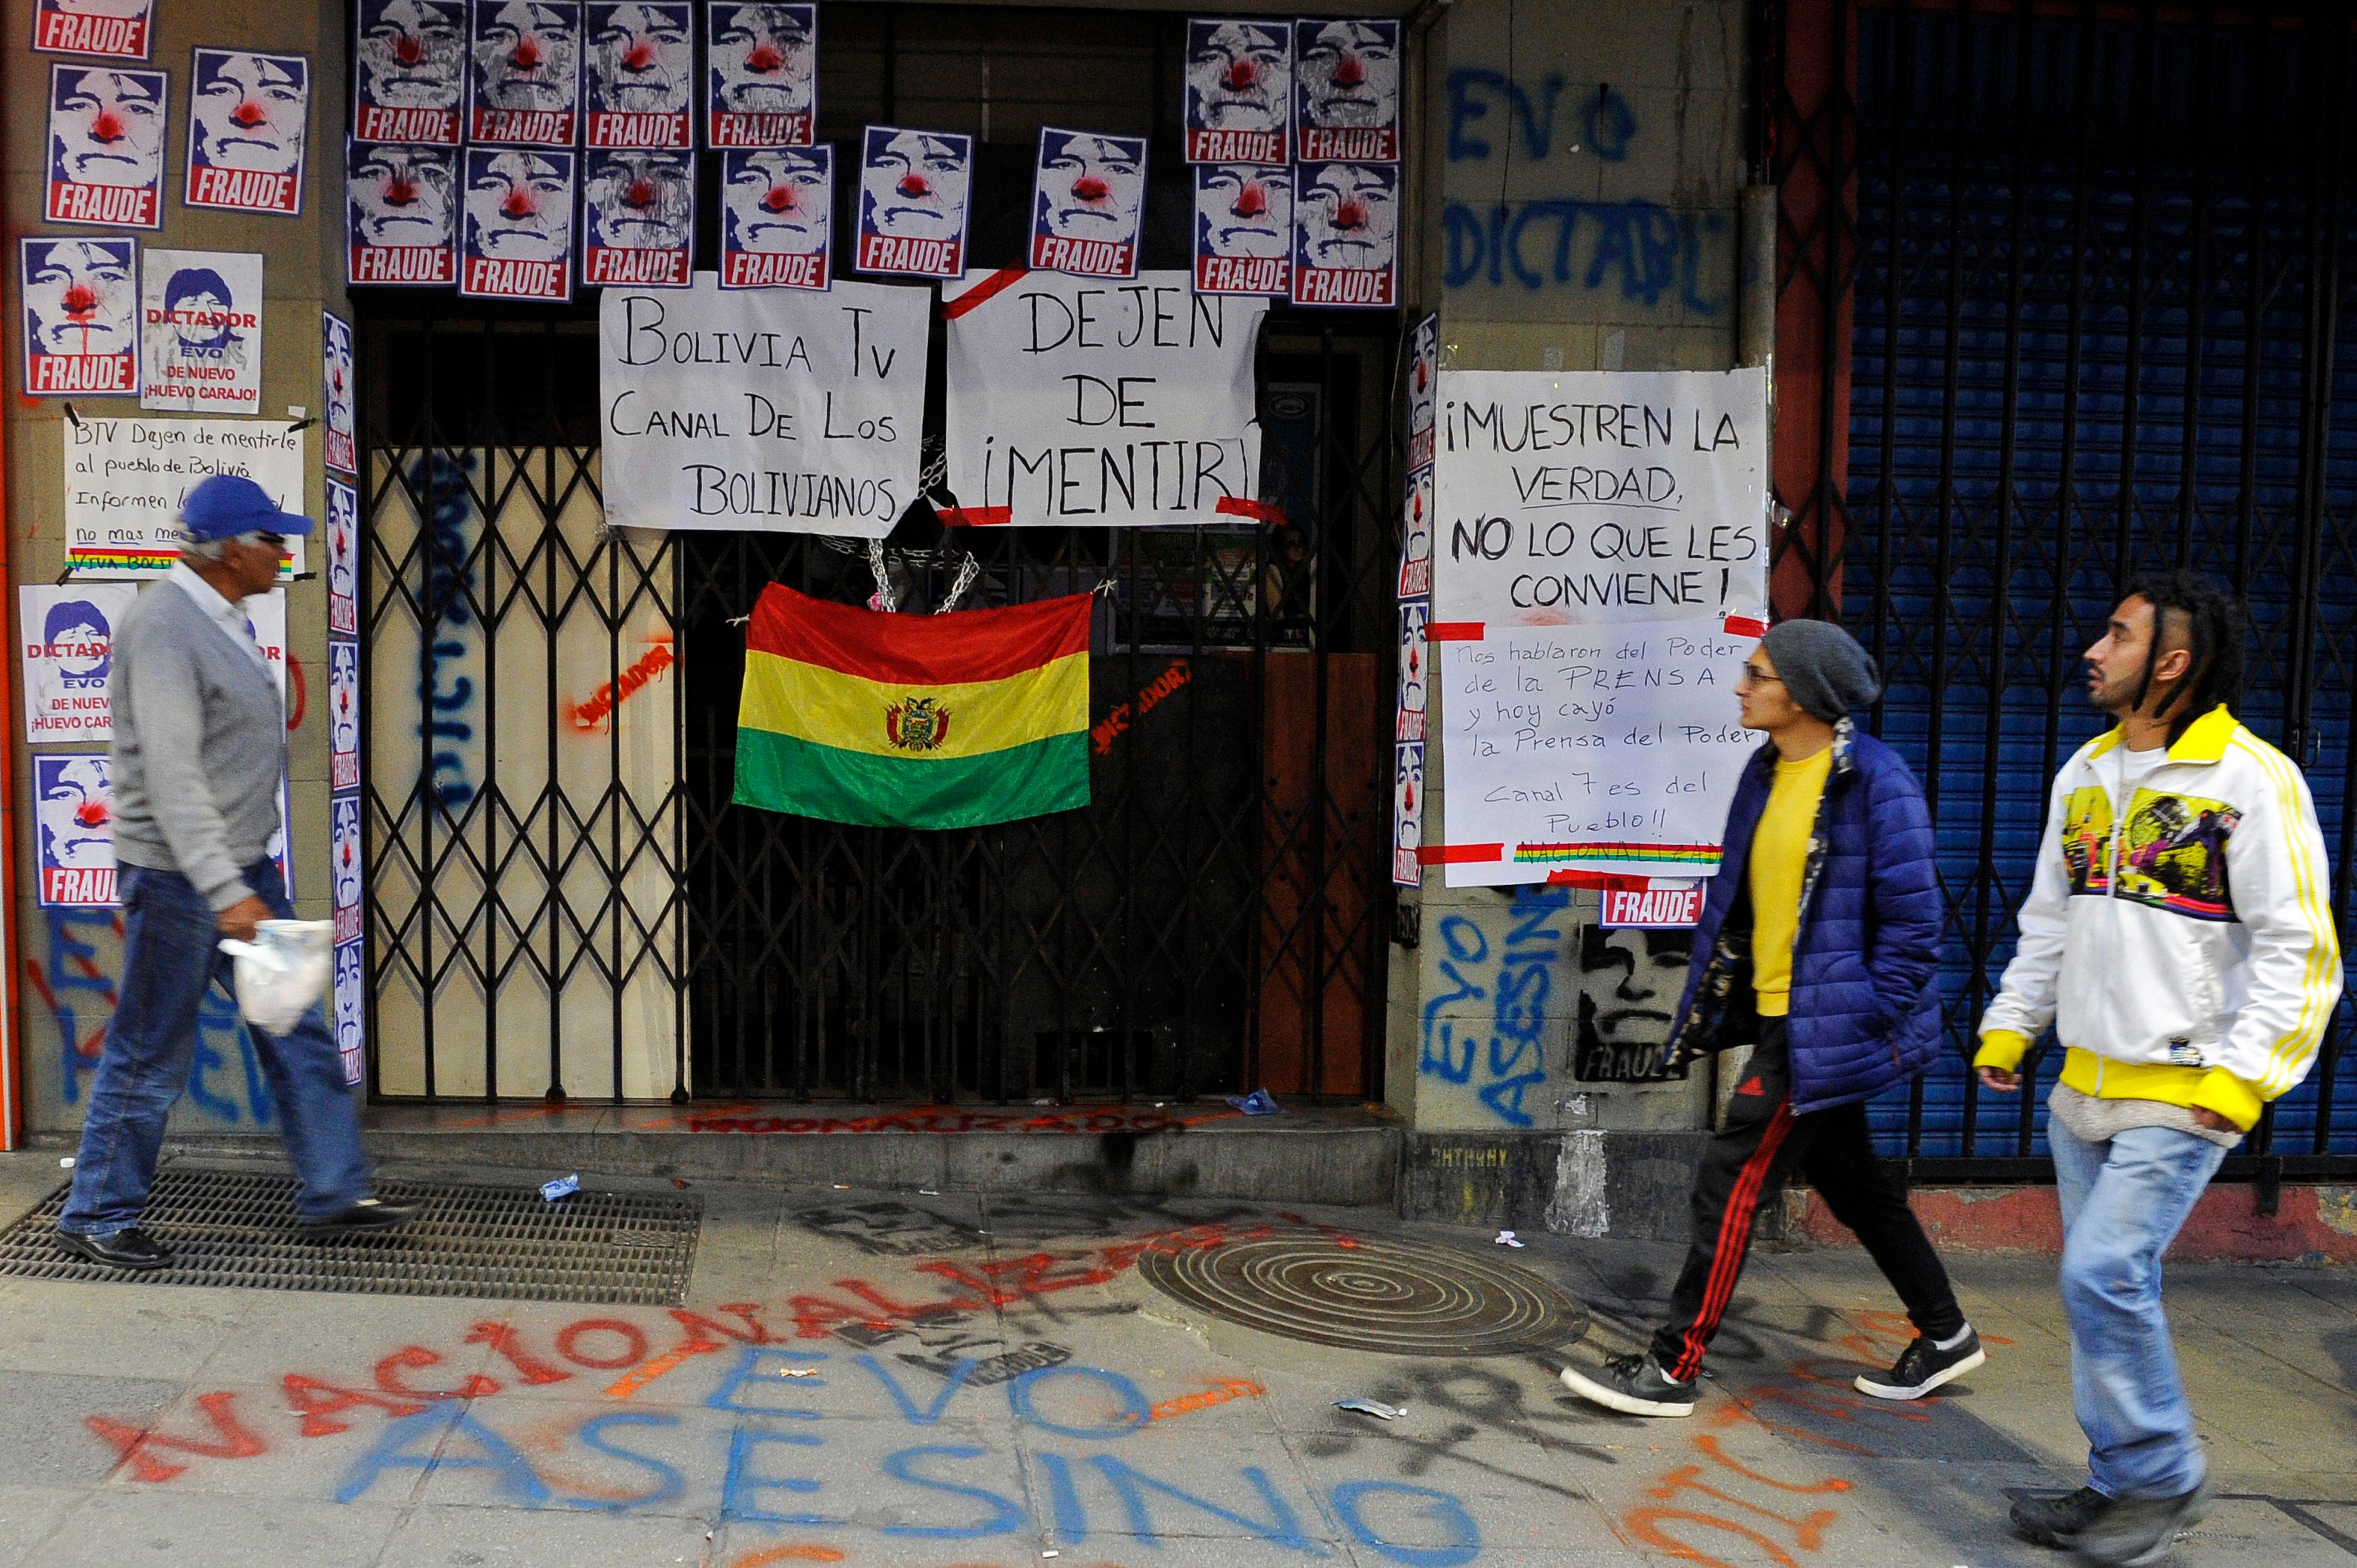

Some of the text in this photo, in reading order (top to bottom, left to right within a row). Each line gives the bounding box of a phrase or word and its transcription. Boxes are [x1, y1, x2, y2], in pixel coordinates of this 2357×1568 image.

[45, 14, 141, 53] FRAUDE
[365, 108, 451, 142] FRAUDE
[481, 111, 569, 144] FRAUDE
[597, 114, 682, 146] FRAUDE
[719, 114, 806, 145] FRAUDE
[1447, 68, 1636, 162] EVO
[1194, 132, 1279, 162] FRAUDE
[1307, 128, 1390, 160] FRAUDE
[56, 185, 150, 222] FRAUDE
[198, 168, 292, 208] FRAUDE
[359, 248, 445, 281] FRAUDE
[593, 249, 680, 282] FRAUDE
[732, 253, 820, 286] FRAUDE
[866, 238, 952, 271] FRAUDE
[1039, 239, 1128, 273] FRAUDE
[471, 260, 560, 295] FRAUDE
[1205, 259, 1287, 291] FRAUDE
[1302, 271, 1385, 302] FRAUDE
[147, 309, 256, 328] DICTADOR
[1018, 286, 1224, 354] DEJEN
[181, 348, 222, 359] EVO
[36, 356, 126, 389] FRAUDE
[167, 365, 235, 380] DE NUEVO
[145, 385, 256, 400] ¡HUEVO CARAJO!
[1061, 375, 1158, 428] DE
[74, 422, 117, 445] BTV
[193, 428, 213, 445] de
[222, 430, 296, 451] mentirle
[1446, 402, 1740, 452] ¡MUESTREN LA
[76, 454, 93, 474] al
[76, 491, 167, 511] Informen
[683, 464, 895, 522] BOLIVIANOS
[1512, 466, 1683, 505] VERDAD,
[76, 527, 96, 542] no
[108, 529, 143, 541] mas
[1451, 513, 1757, 563] NO LO QUE LES
[27, 642, 113, 658] DICTAD
[1508, 641, 1602, 662] hablaron
[1616, 642, 1645, 661] del
[1666, 637, 1743, 659] Poder
[64, 679, 105, 688] EVO
[1465, 665, 1715, 694] de la PRENSA
[52, 697, 110, 710] DE NUEV
[1464, 696, 1617, 731] y hoy cayó
[31, 717, 81, 732] ¡HUEVO
[1472, 723, 1754, 757] la Prensa del Poder
[1484, 771, 1706, 804] Canal 7 es del
[1548, 808, 1665, 838] Pueblo!!
[1521, 840, 1723, 866] NACIONALIZAD
[51, 870, 121, 902] FRAU
[1612, 891, 1698, 923] FRAUDE
[704, 1343, 1150, 1440] EVO
